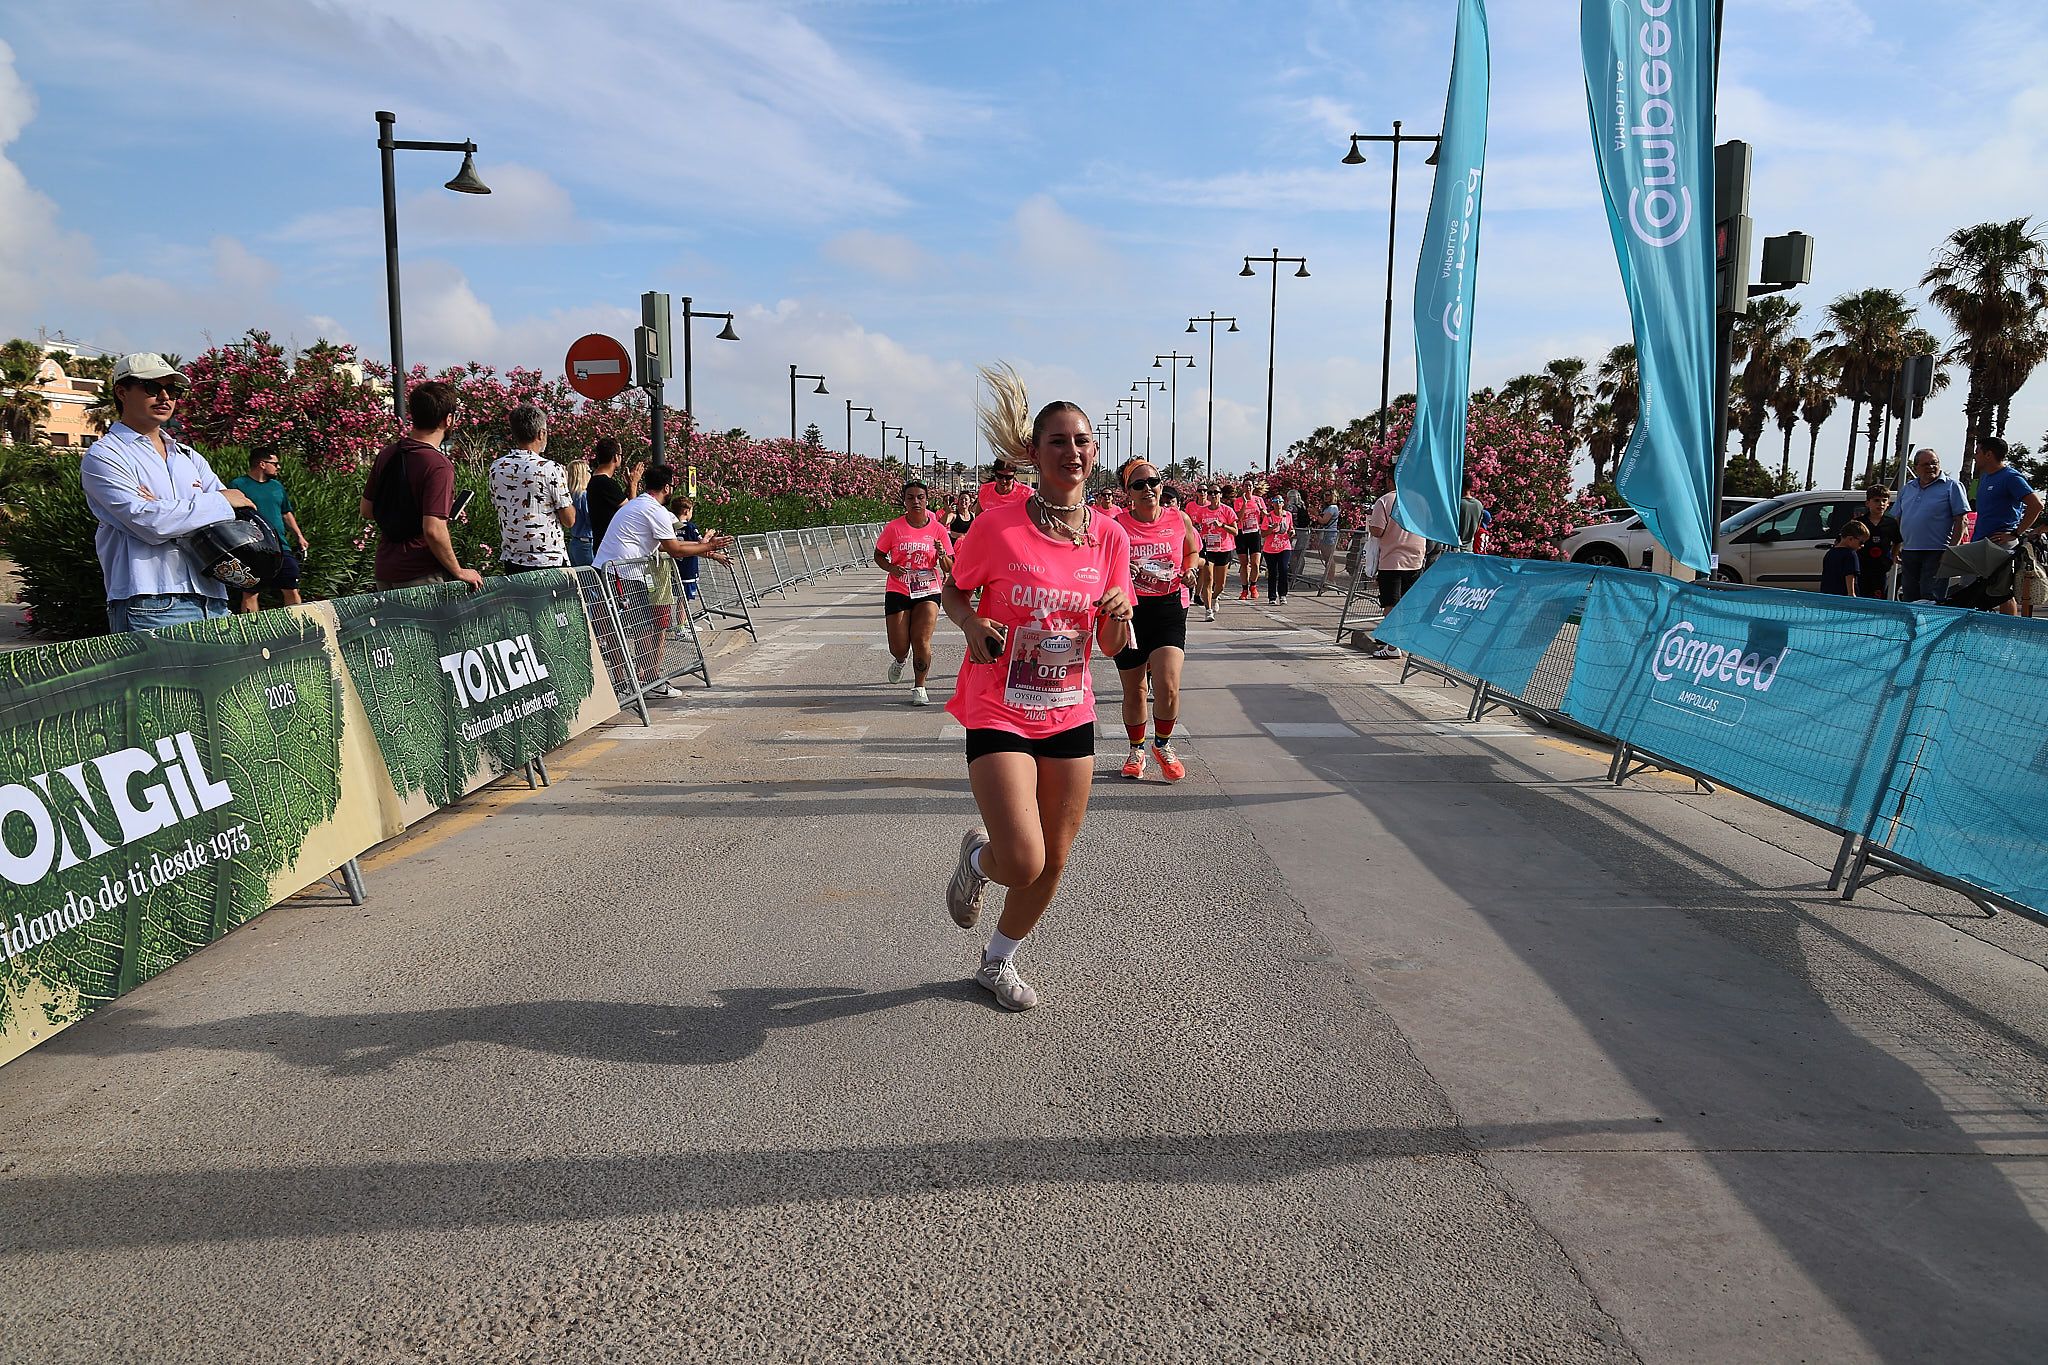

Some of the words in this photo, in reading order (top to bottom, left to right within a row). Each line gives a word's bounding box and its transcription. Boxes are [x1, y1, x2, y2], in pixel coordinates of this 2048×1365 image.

[1008, 562, 1046, 574] OYSHO
[1011, 584, 1092, 613] CARRERA
[371, 646, 394, 669] 1975
[1652, 621, 1789, 692] Compeed
[1037, 665, 1067, 679] 016
[264, 680, 297, 711] 2026
[1014, 692, 1042, 702] OYSHO
[1677, 690, 1719, 712] AMPOLLAS
[461, 709, 504, 742] Cuidando
[502, 703, 514, 723] de
[512, 700, 522, 722] ti
[521, 693, 543, 718] desde
[542, 690, 559, 710] 1975
[1024, 710, 1047, 721] 2026
[99, 874, 128, 912] de
[128, 861, 149, 898] ti
[150, 838, 208, 888] desde
[209, 822, 251, 861] 1975
